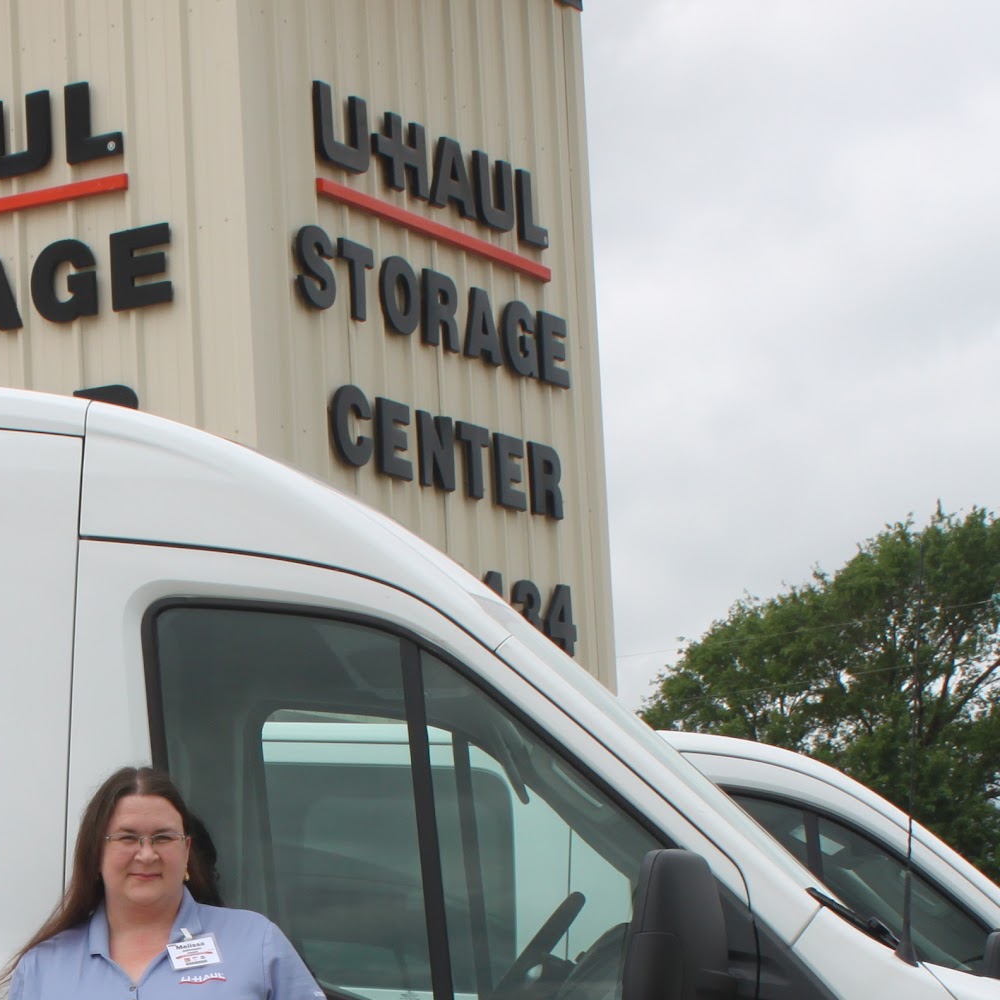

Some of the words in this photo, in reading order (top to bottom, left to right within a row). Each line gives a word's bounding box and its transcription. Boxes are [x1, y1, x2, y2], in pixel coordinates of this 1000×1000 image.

[312, 80, 549, 248] U-HAUL
[294, 225, 571, 388] STORAGE
[330, 384, 564, 520] CENTER
